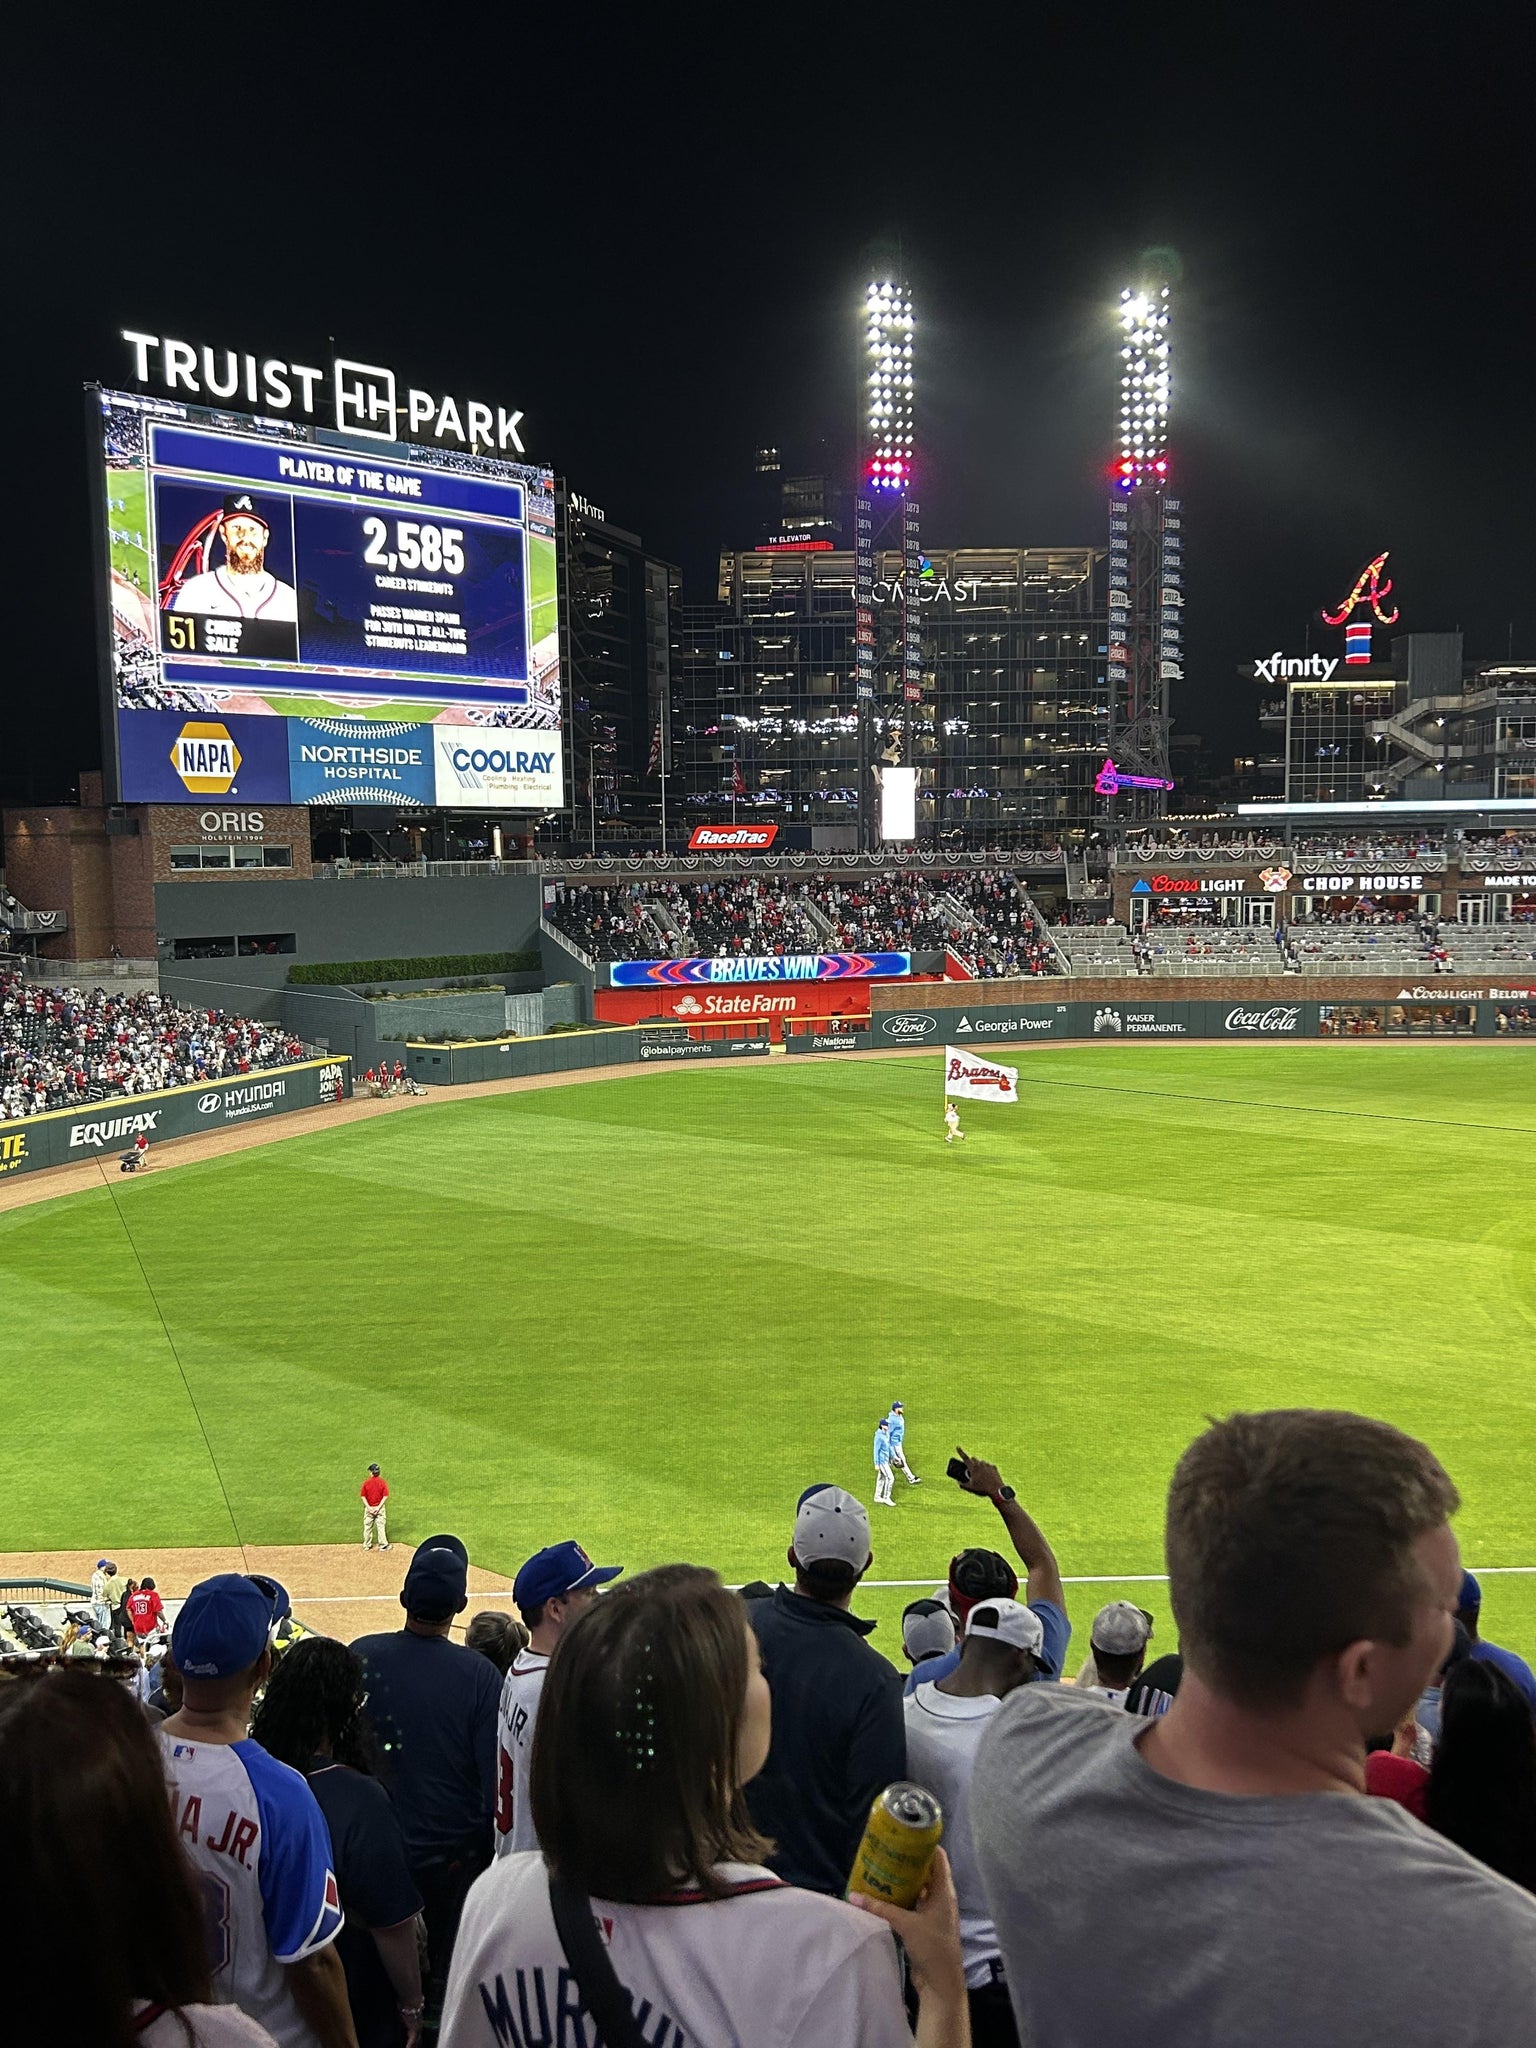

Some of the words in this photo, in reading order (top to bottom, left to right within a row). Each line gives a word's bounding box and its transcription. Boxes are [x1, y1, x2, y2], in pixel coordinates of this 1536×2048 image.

[122, 329, 324, 414] TRUIST
[409, 388, 526, 454] PARK
[279, 456, 335, 484] PLAYER
[336, 466, 354, 486] OF
[357, 469, 384, 491] THE
[385, 473, 422, 496] GAME
[858, 499, 871, 511] 1872
[906, 502, 920, 514] 1873
[1165, 500, 1180, 510] 1997
[858, 519, 871, 530] 1874
[906, 521, 920, 532] 1875
[1112, 520, 1128, 531] 1998
[1164, 518, 1180, 529] 1999
[779, 534, 811, 543] ELEVATOR
[858, 537, 871, 548] 1877
[1111, 539, 1128, 549] 2000
[1164, 537, 1180, 548] 2001
[363, 516, 465, 575] 2,585
[906, 540, 920, 551] 1878
[1111, 557, 1128, 568] 2002
[1164, 555, 1180, 566] 2003
[1111, 575, 1128, 586] 2004
[1164, 574, 1180, 584] 2005
[375, 574, 406, 590] CAREER
[407, 578, 453, 596] STRIKEOUTS
[1111, 593, 1127, 604] 2010
[1164, 592, 1179, 602] 2012
[1111, 612, 1126, 623] 2013
[1163, 610, 1179, 621] 2018
[169, 616, 195, 650] 51
[415, 623, 431, 637] THE
[432, 625, 467, 640] ALL-TIME
[858, 631, 872, 642] 1957
[1111, 630, 1126, 641] 2019
[1163, 628, 1179, 639] 2020
[205, 635, 239, 653] SALE
[364, 633, 414, 650] STRIKEOUTS
[414, 638, 467, 655] LEADERBOARD
[858, 650, 873, 661] 1969
[1111, 648, 1125, 659] 2021
[1163, 646, 1178, 657] 2022
[1163, 665, 1178, 675] 2024
[1254, 652, 1339, 683] xfinity
[858, 668, 872, 679] 1991
[906, 668, 920, 680] 1992
[1110, 668, 1126, 679] 2023
[858, 686, 873, 698] 1993
[906, 687, 920, 698] 1995
[184, 743, 231, 773] NAPA
[301, 745, 422, 766] NORTHSIDE
[453, 748, 556, 774] COOLRAY
[325, 766, 402, 780] HOSPITAL
[483, 775, 507, 783] Cooling
[512, 776, 536, 784] Heating
[489, 783, 518, 791] Plumbing
[200, 811, 264, 832] ORIS
[696, 830, 768, 844] RaceTrac
[1152, 874, 1200, 893] Coors
[1200, 879, 1246, 892] LIGHT
[1303, 876, 1354, 891] CHOP
[1359, 876, 1423, 890] HOUSE
[1485, 876, 1520, 886] MADE
[1521, 875, 1536, 886] TO
[710, 956, 781, 983] BRAVES
[784, 956, 819, 980] WIN
[1412, 986, 1450, 1000] Coors
[1450, 990, 1484, 1000] LIGHT
[1489, 988, 1529, 999] BELOW
[704, 995, 751, 1014] State
[751, 995, 796, 1012] Farm
[1126, 1014, 1155, 1022] KAISER
[1225, 1006, 1301, 1031] Coca-Cola
[892, 1017, 927, 1033] Ford
[975, 1019, 1017, 1034] Georgia
[1020, 1018, 1053, 1030] Power
[1126, 1023, 1184, 1032] PERMANENTE
[823, 1036, 856, 1046] National
[320, 1064, 343, 1082] PAPA
[948, 1058, 1000, 1081] Braves
[225, 1080, 286, 1107] HYUNDAI
[70, 1111, 158, 1147] EQUIFAX
[135, 1601, 148, 1615] 13
[207, 1810, 259, 1871] JR.
